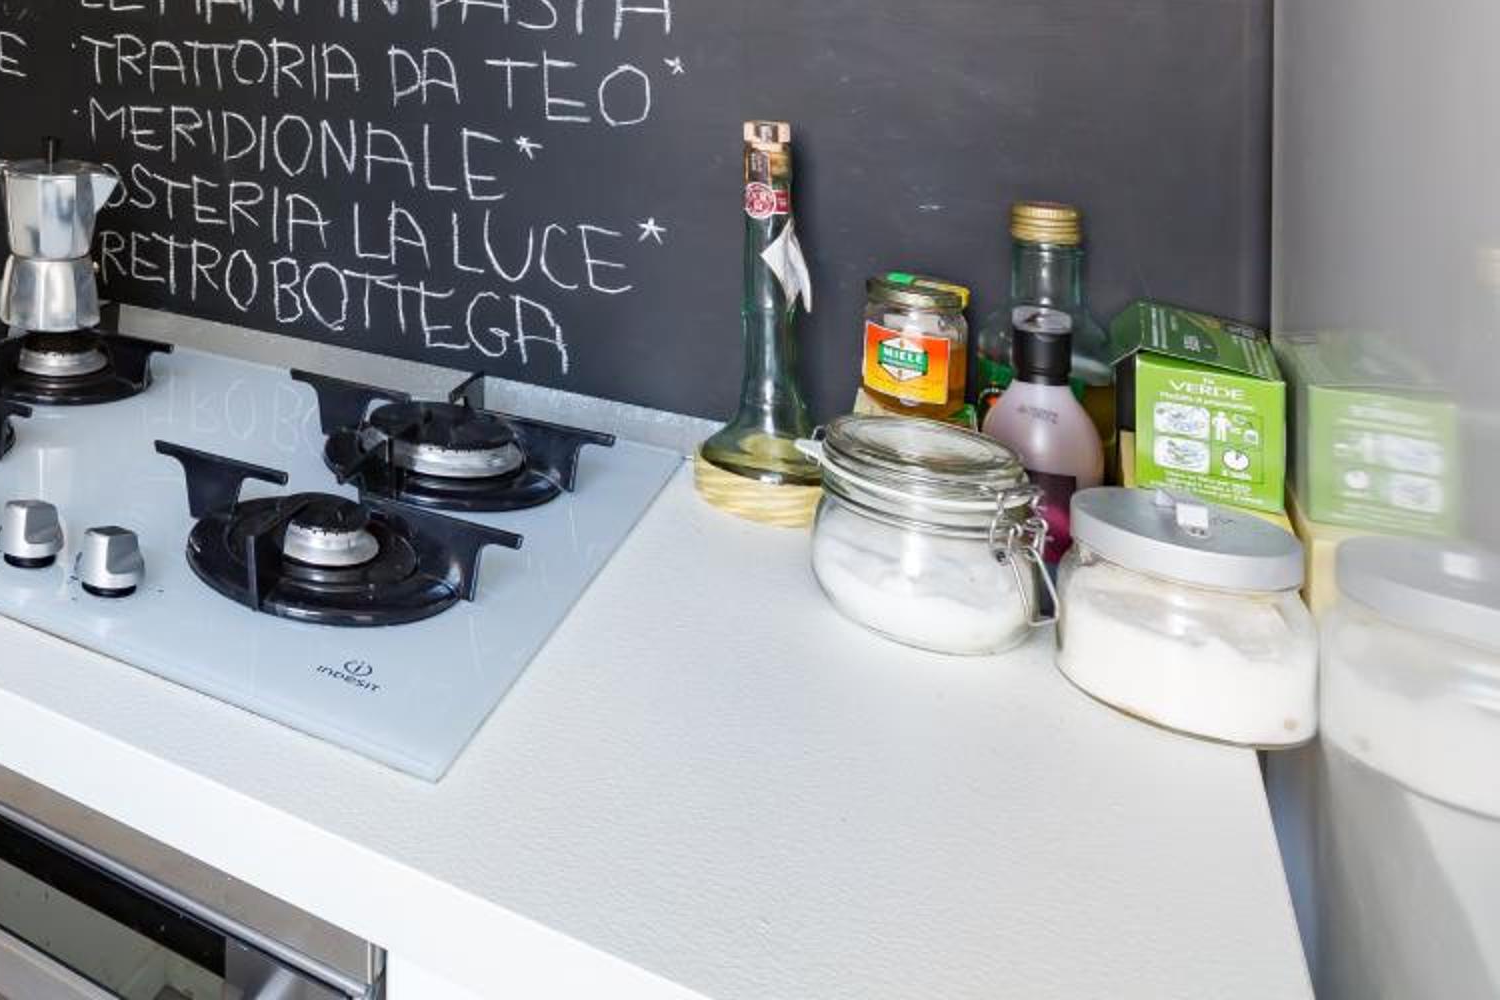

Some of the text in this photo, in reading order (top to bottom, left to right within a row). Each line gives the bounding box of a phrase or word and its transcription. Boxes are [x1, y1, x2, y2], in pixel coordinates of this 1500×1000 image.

[81, 33, 651, 126] TRATTORIA DA TEO
[89, 97, 507, 201] MERIDIONALE
[102, 163, 633, 294] OSTERIA LA LUCE
[1169, 379, 1246, 401] VERDE
